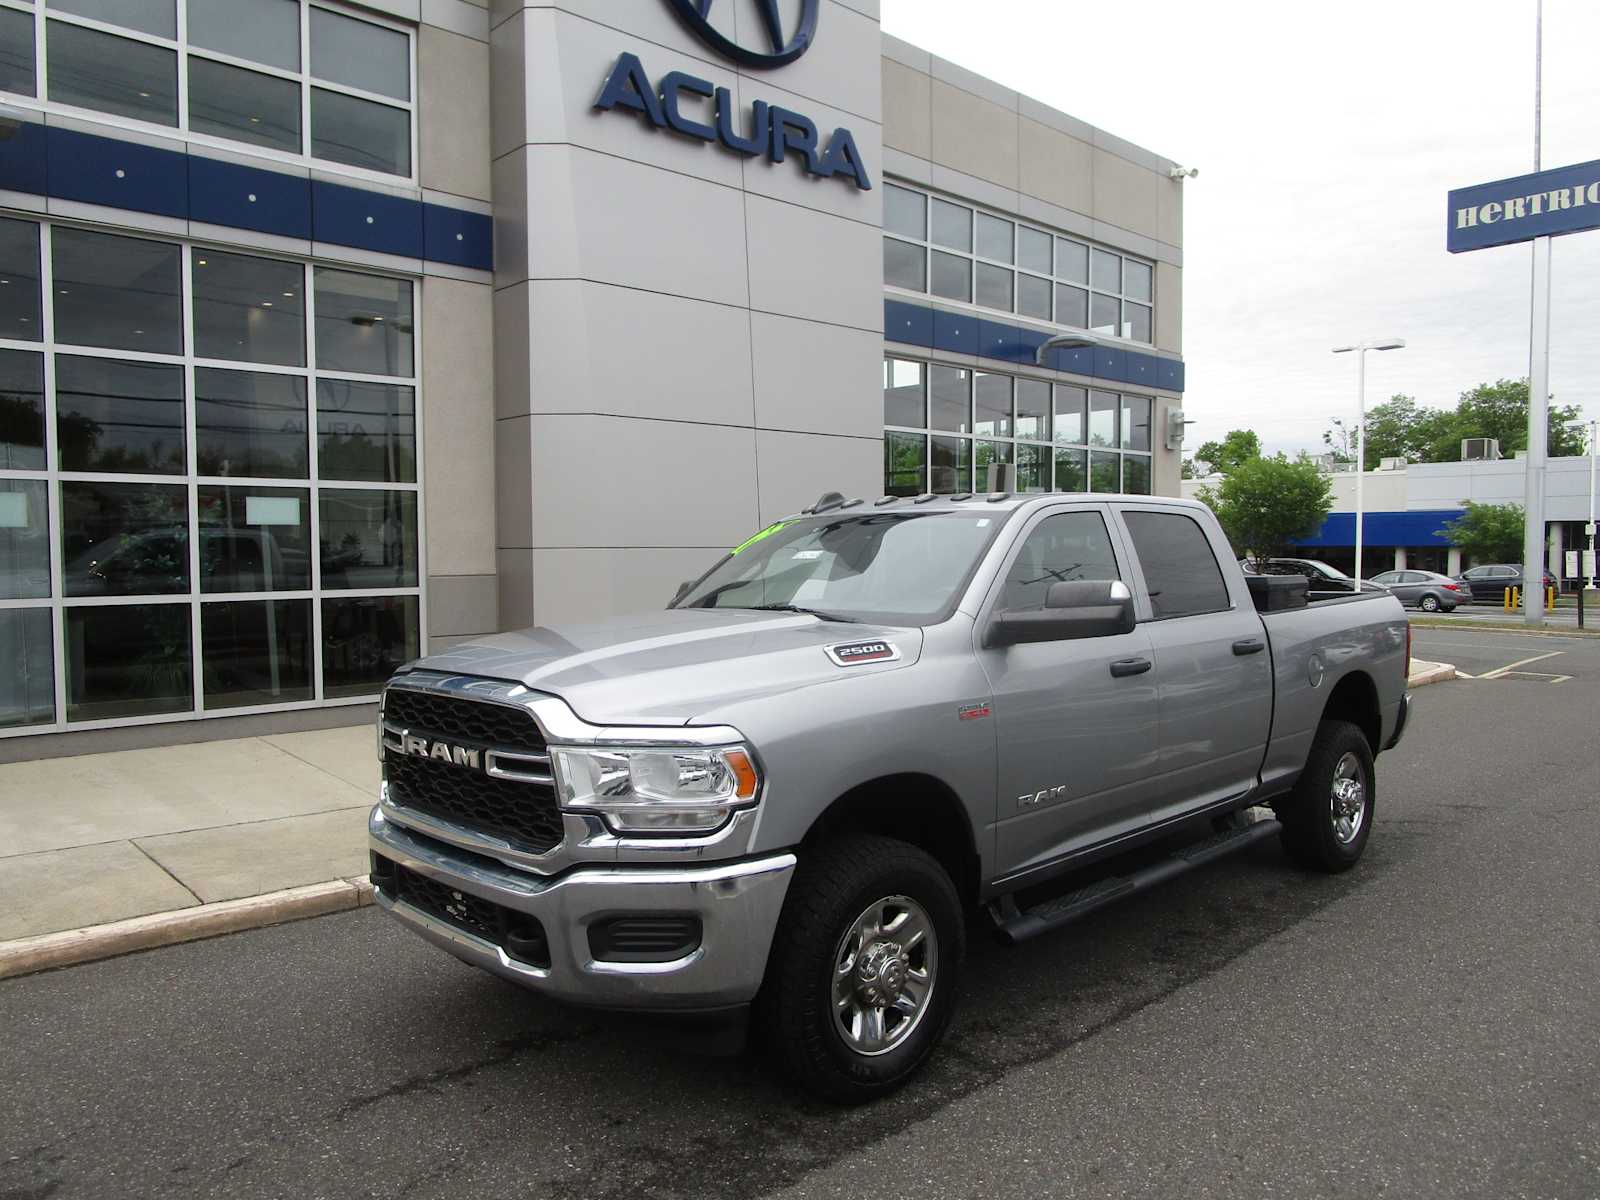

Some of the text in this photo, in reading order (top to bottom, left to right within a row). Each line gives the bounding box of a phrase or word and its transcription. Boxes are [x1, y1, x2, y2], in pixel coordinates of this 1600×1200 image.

[593, 51, 872, 190] ACURA
[839, 644, 885, 656] 2500
[406, 734, 480, 769] RAM
